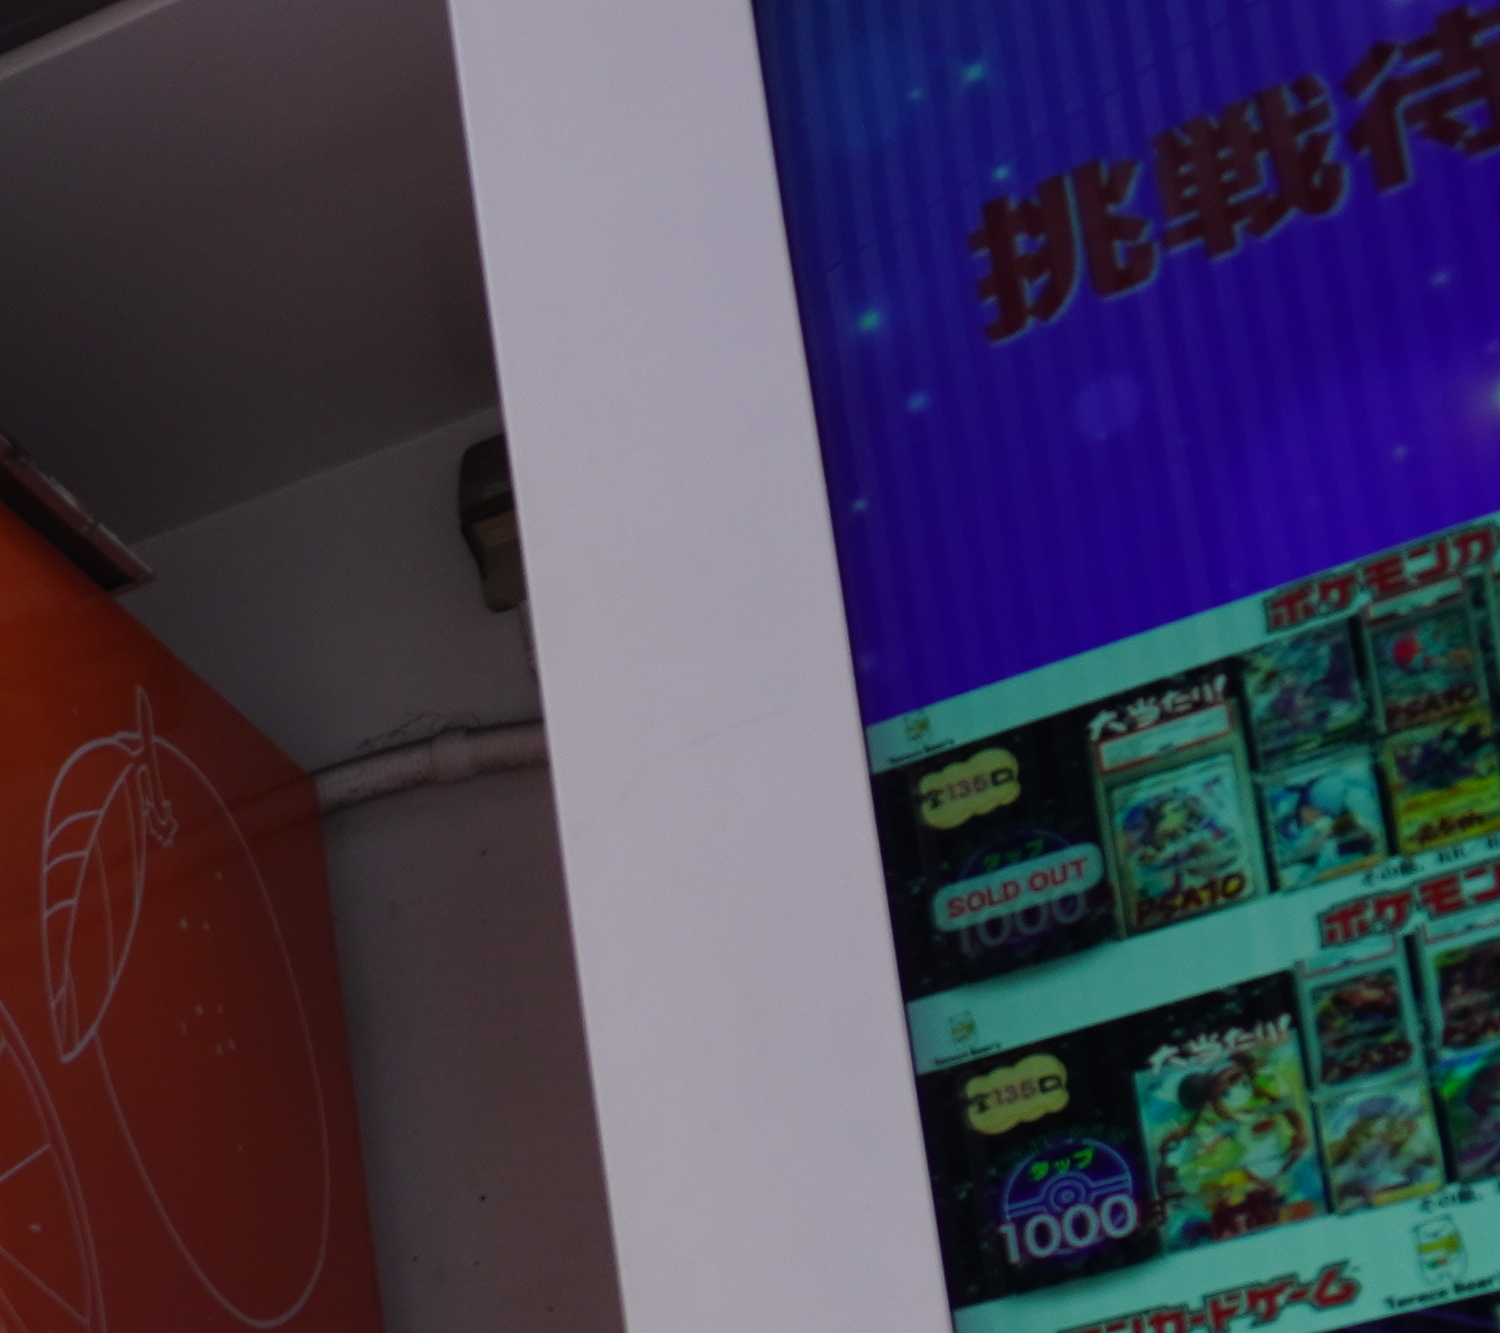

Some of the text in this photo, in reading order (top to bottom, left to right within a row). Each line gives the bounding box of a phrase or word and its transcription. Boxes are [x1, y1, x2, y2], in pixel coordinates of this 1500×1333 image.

[946, 857, 1088, 921] SOLD OUT
[1000, 1196, 1139, 1266] 1000
